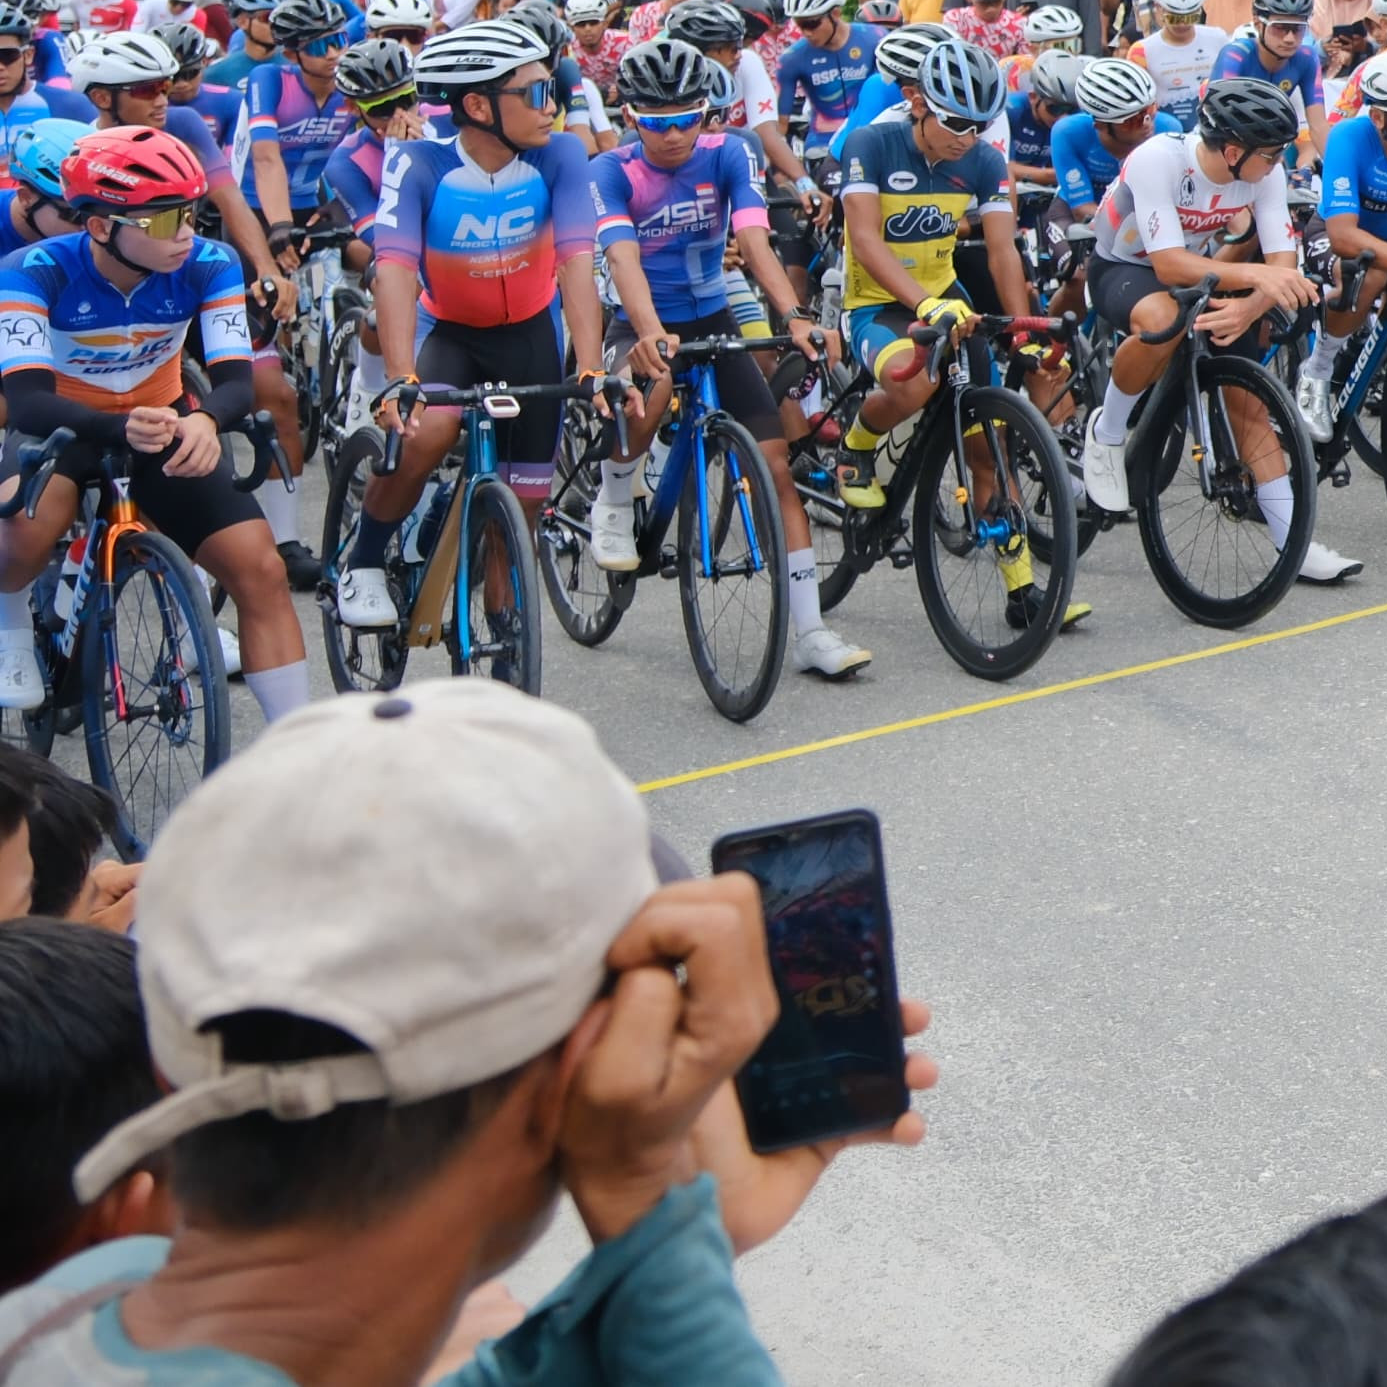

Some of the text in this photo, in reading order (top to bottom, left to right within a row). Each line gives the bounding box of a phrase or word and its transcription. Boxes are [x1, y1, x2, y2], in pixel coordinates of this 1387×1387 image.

[456, 55, 495, 65] LAZER
[277, 117, 346, 135] ASC
[86, 160, 141, 187] LIMAR
[374, 145, 412, 229] NC
[452, 205, 535, 240] NC
[638, 196, 717, 227] ASC
[450, 230, 537, 249] PROCYCLING
[636, 218, 718, 239] MONSTERS
[1331, 320, 1383, 423] POLYGON
